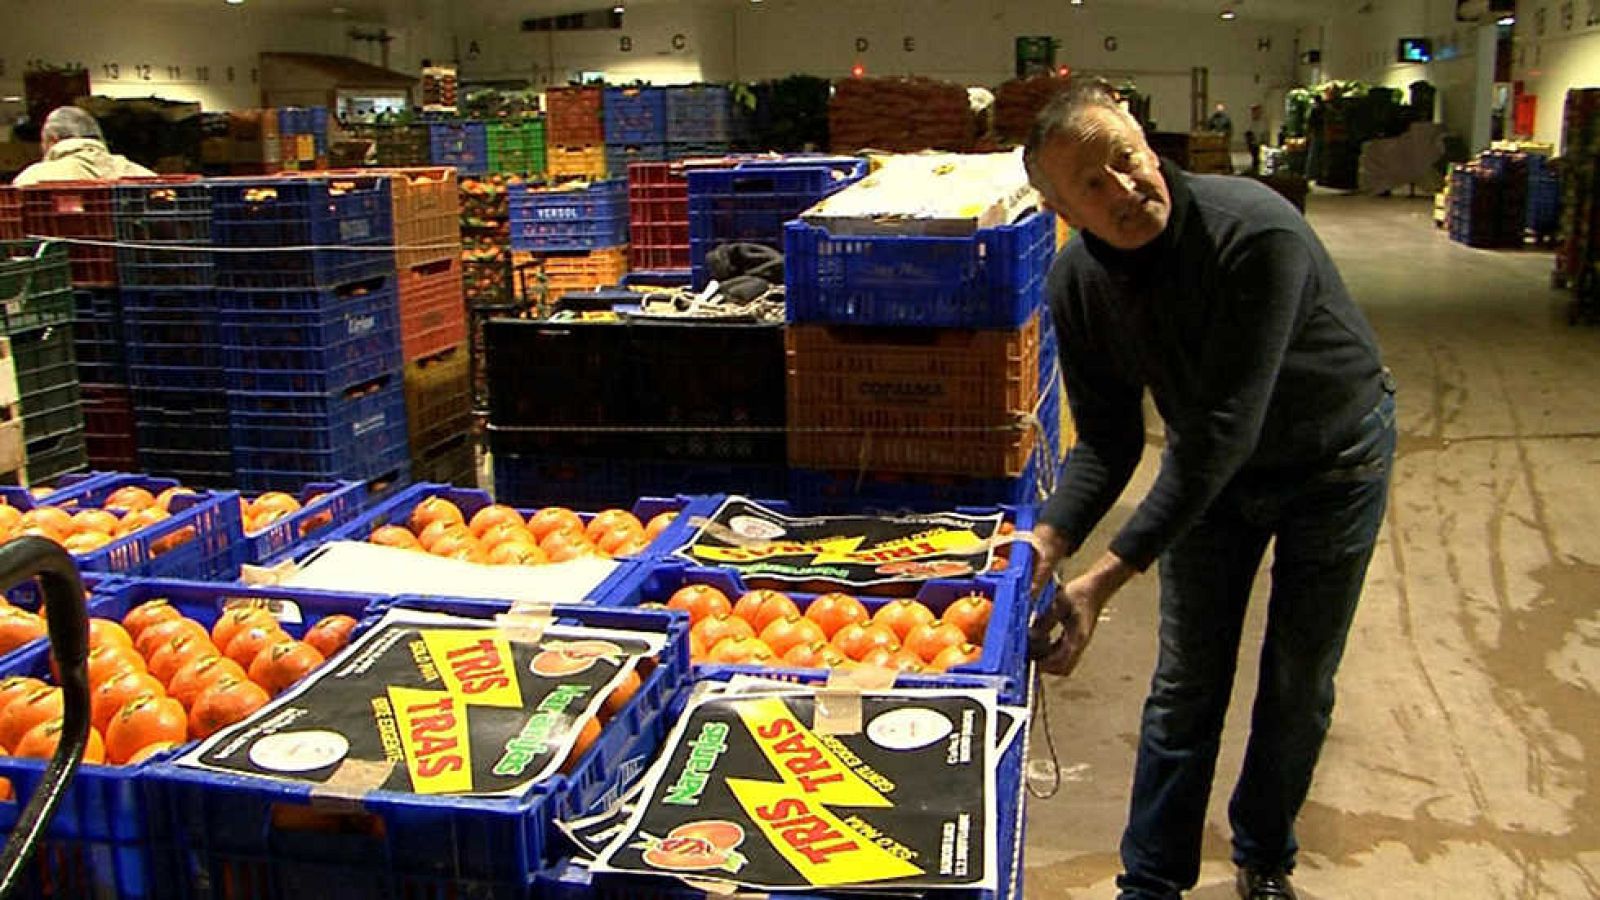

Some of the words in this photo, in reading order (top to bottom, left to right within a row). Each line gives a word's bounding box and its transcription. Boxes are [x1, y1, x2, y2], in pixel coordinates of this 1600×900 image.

[469, 41, 480, 54] A
[620, 36, 632, 52] B
[671, 34, 686, 49] C
[855, 38, 869, 52] D
[903, 37, 916, 52] E
[1104, 37, 1117, 52] G
[1258, 38, 1270, 51] H
[103, 63, 119, 79] 13
[135, 64, 151, 80] 12
[168, 65, 181, 79] 11
[446, 639, 510, 694] TRIS
[407, 697, 464, 777] TRAS
[493, 684, 592, 775] Naranjas
[662, 722, 730, 804] Naranjas
[757, 718, 845, 793] TRAS
[756, 798, 859, 864] TRIS
